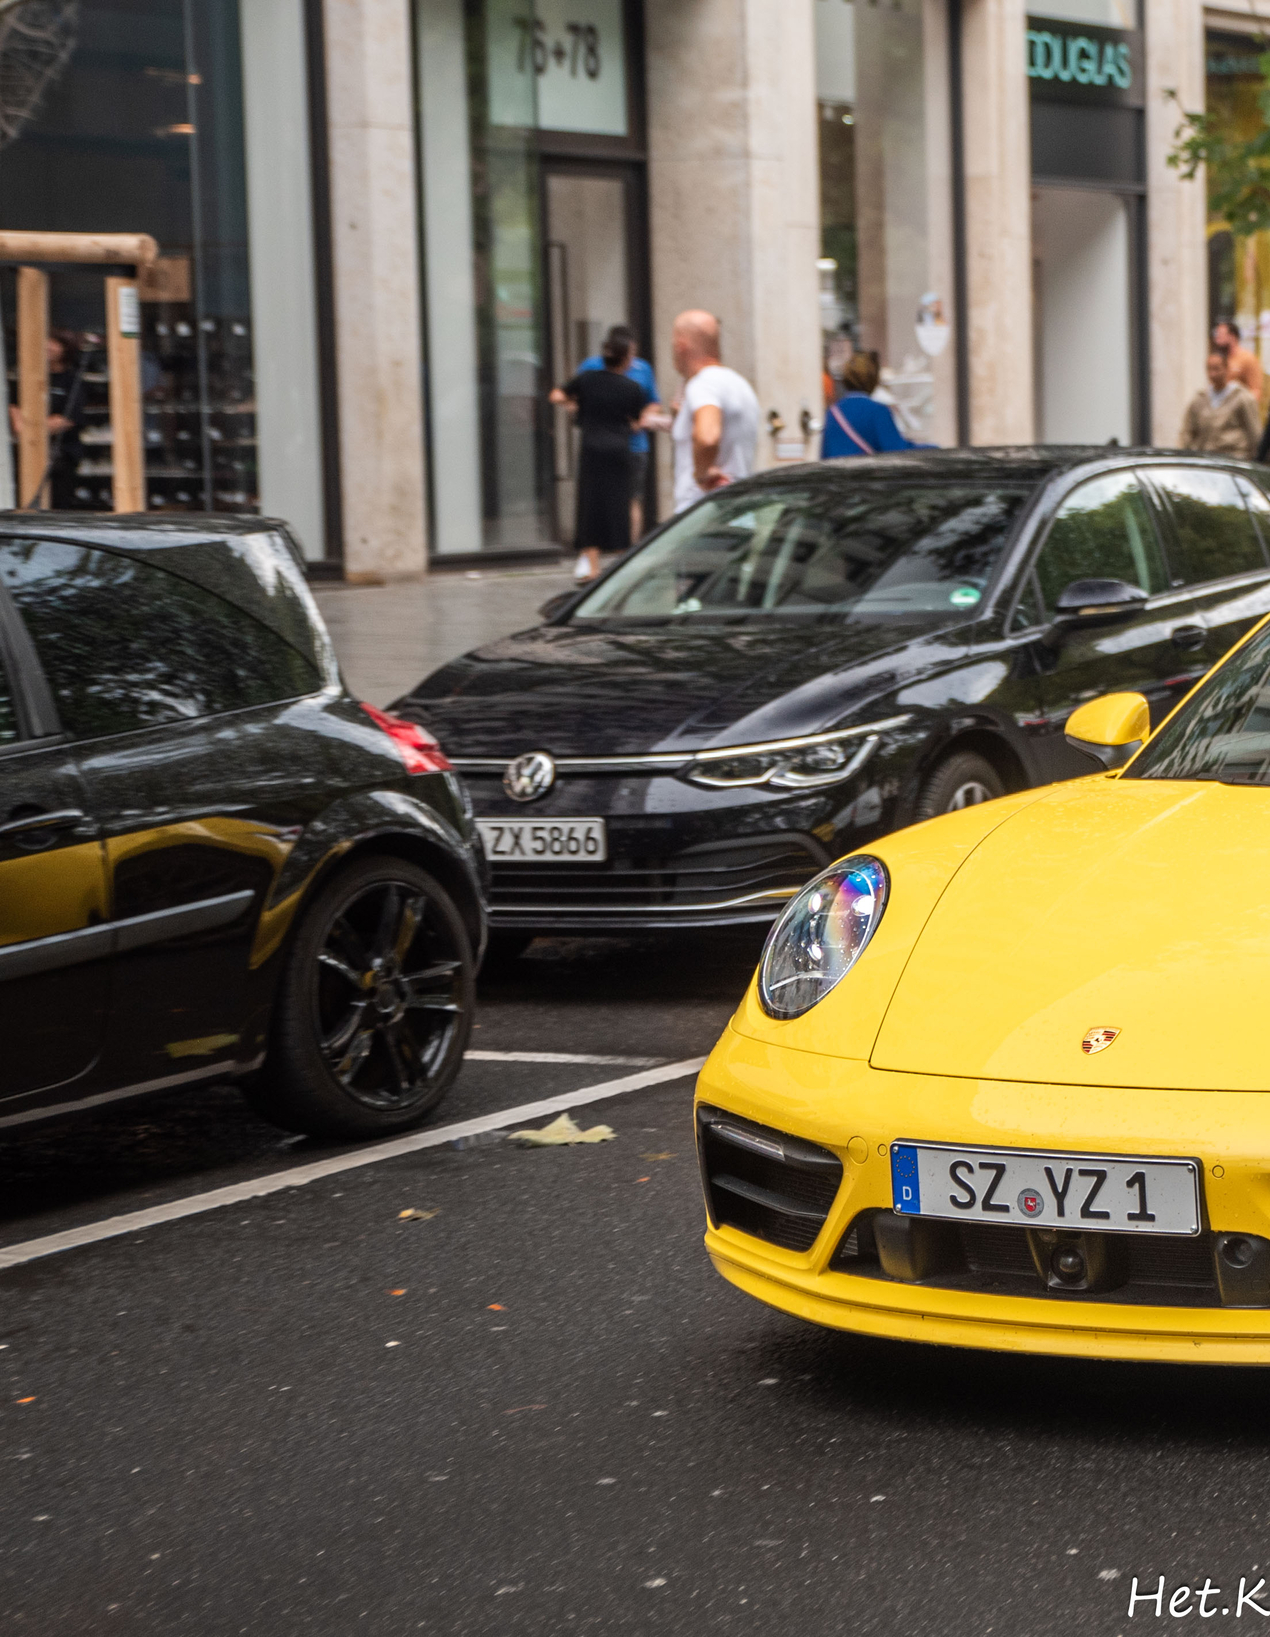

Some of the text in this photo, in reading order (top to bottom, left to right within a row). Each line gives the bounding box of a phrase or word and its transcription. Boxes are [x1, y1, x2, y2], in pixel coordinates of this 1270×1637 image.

[513, 15, 601, 81] 76+78
[1025, 29, 1132, 89] DOUGLAS
[489, 826, 598, 856] ZX 5866
[902, 1185, 912, 1201] D
[949, 1160, 1010, 1213] SZ
[1043, 1166, 1110, 1220] YZ
[1125, 1171, 1156, 1222] 1
